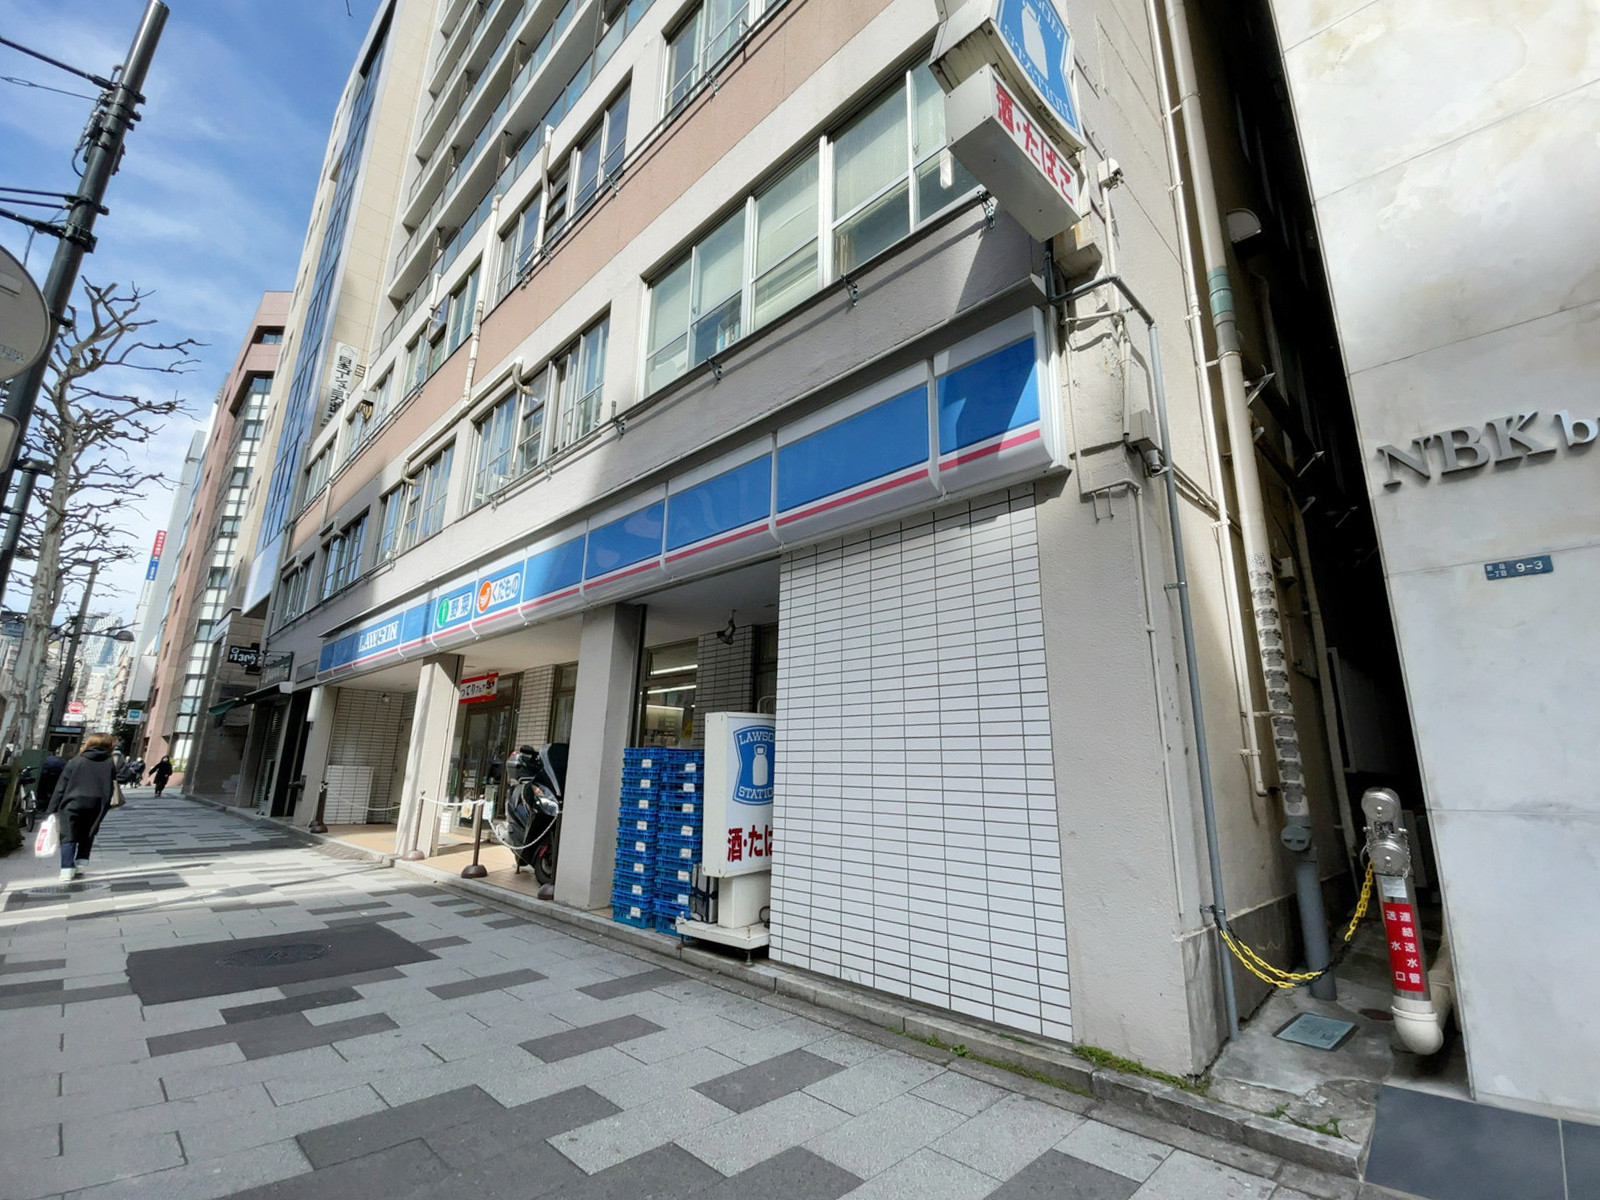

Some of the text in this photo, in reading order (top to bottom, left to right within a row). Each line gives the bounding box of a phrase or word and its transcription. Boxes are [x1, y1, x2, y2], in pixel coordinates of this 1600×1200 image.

[1003, 22, 1073, 122] STATION
[996, 82, 1075, 205] 酒・たばこ
[1376, 408, 1600, 488] NBK b
[1515, 560, 1544, 573] 9-3
[358, 621, 399, 651] LAWSON
[738, 731, 775, 745] LAWSO
[737, 785, 774, 799] STATIO
[1385, 909, 1407, 983] 送水口
[1399, 911, 1421, 985] 連結送水管
